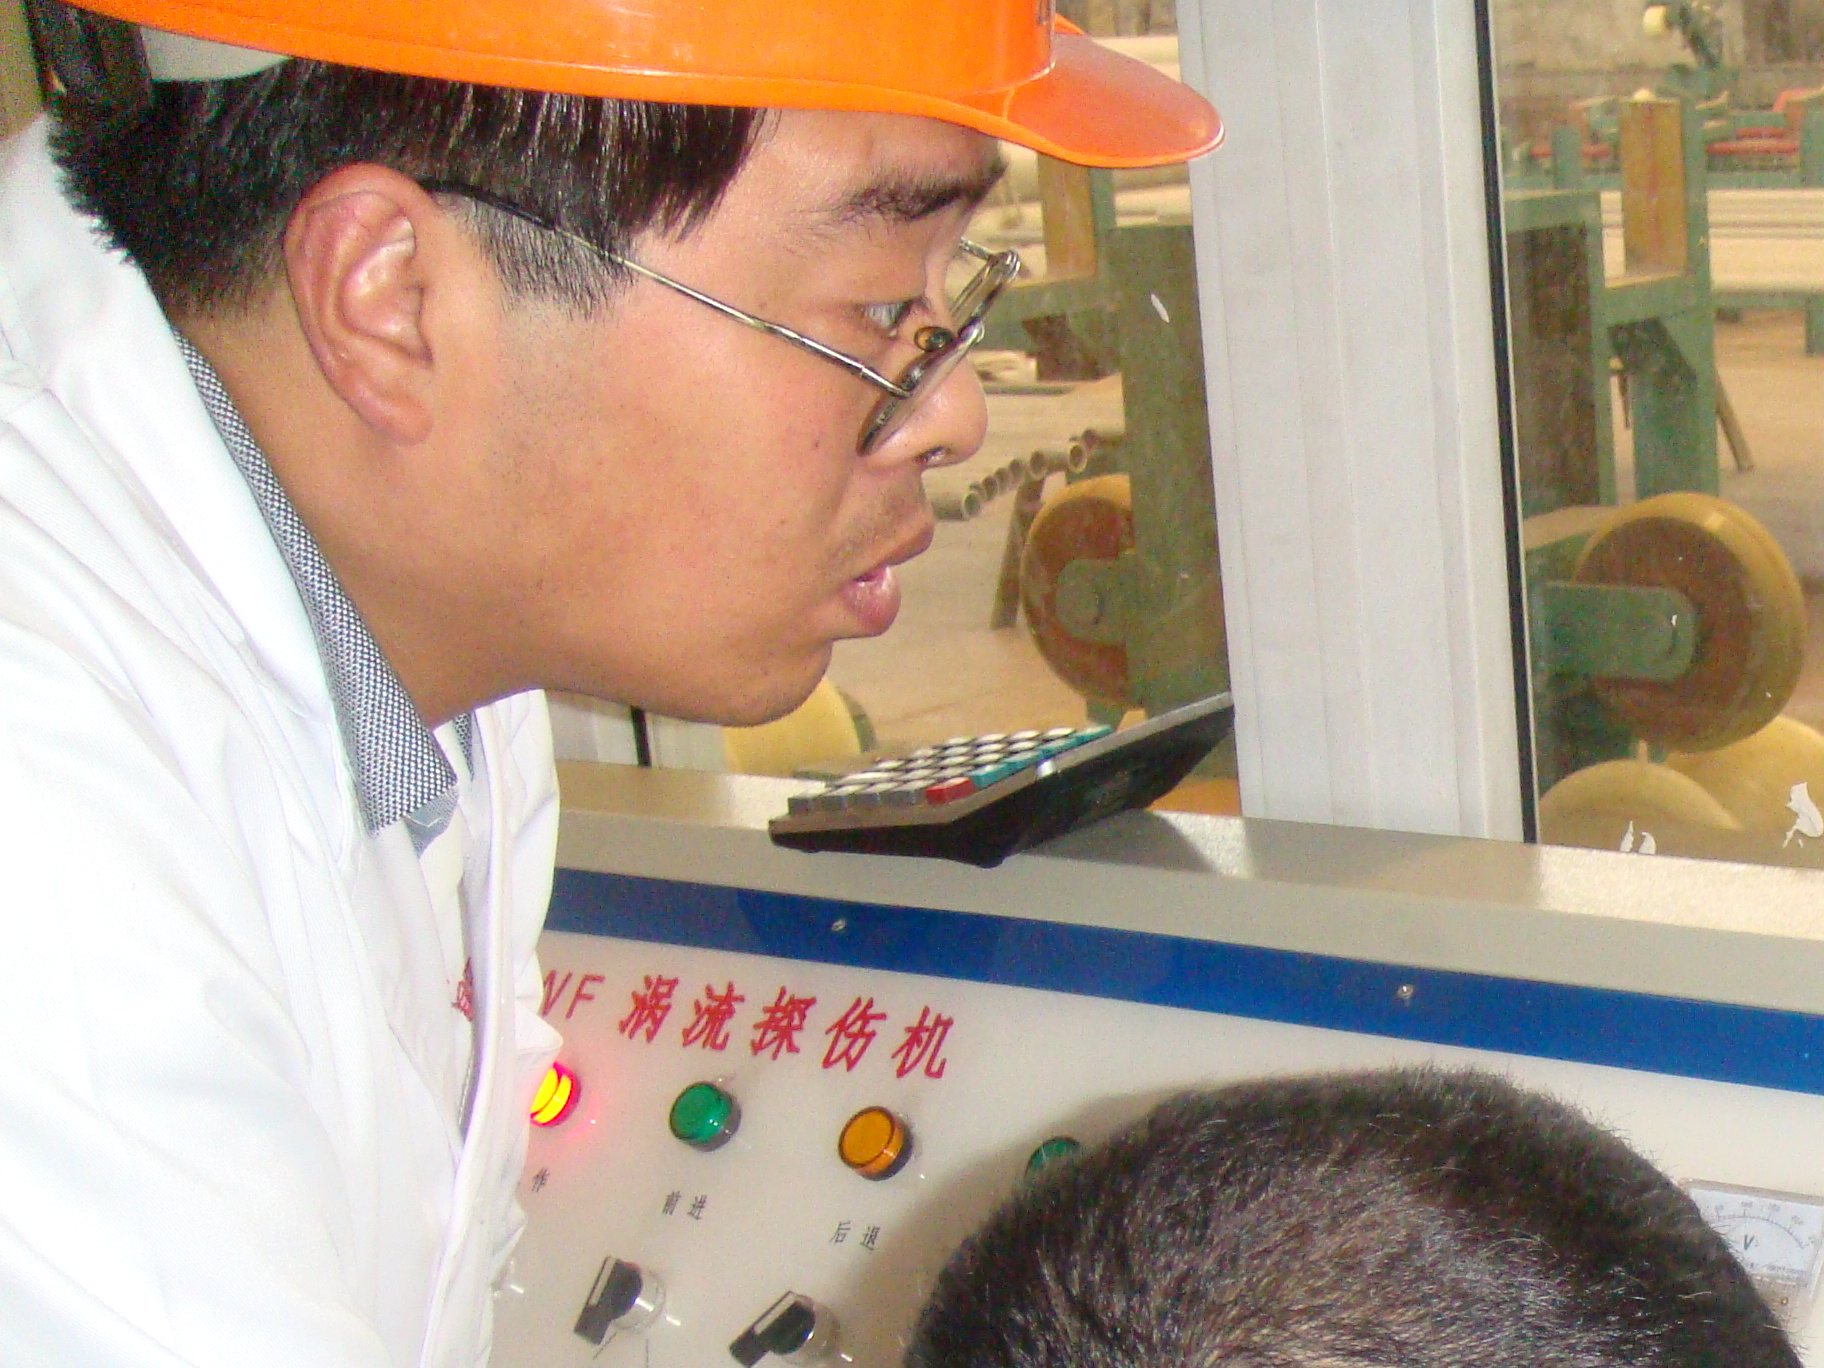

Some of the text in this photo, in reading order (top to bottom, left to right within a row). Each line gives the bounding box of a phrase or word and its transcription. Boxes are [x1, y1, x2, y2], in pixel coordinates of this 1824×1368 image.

[618, 974, 954, 1080] 涡流探伤机
[661, 1190, 708, 1221] 前进
[828, 1219, 881, 1251] 后退
